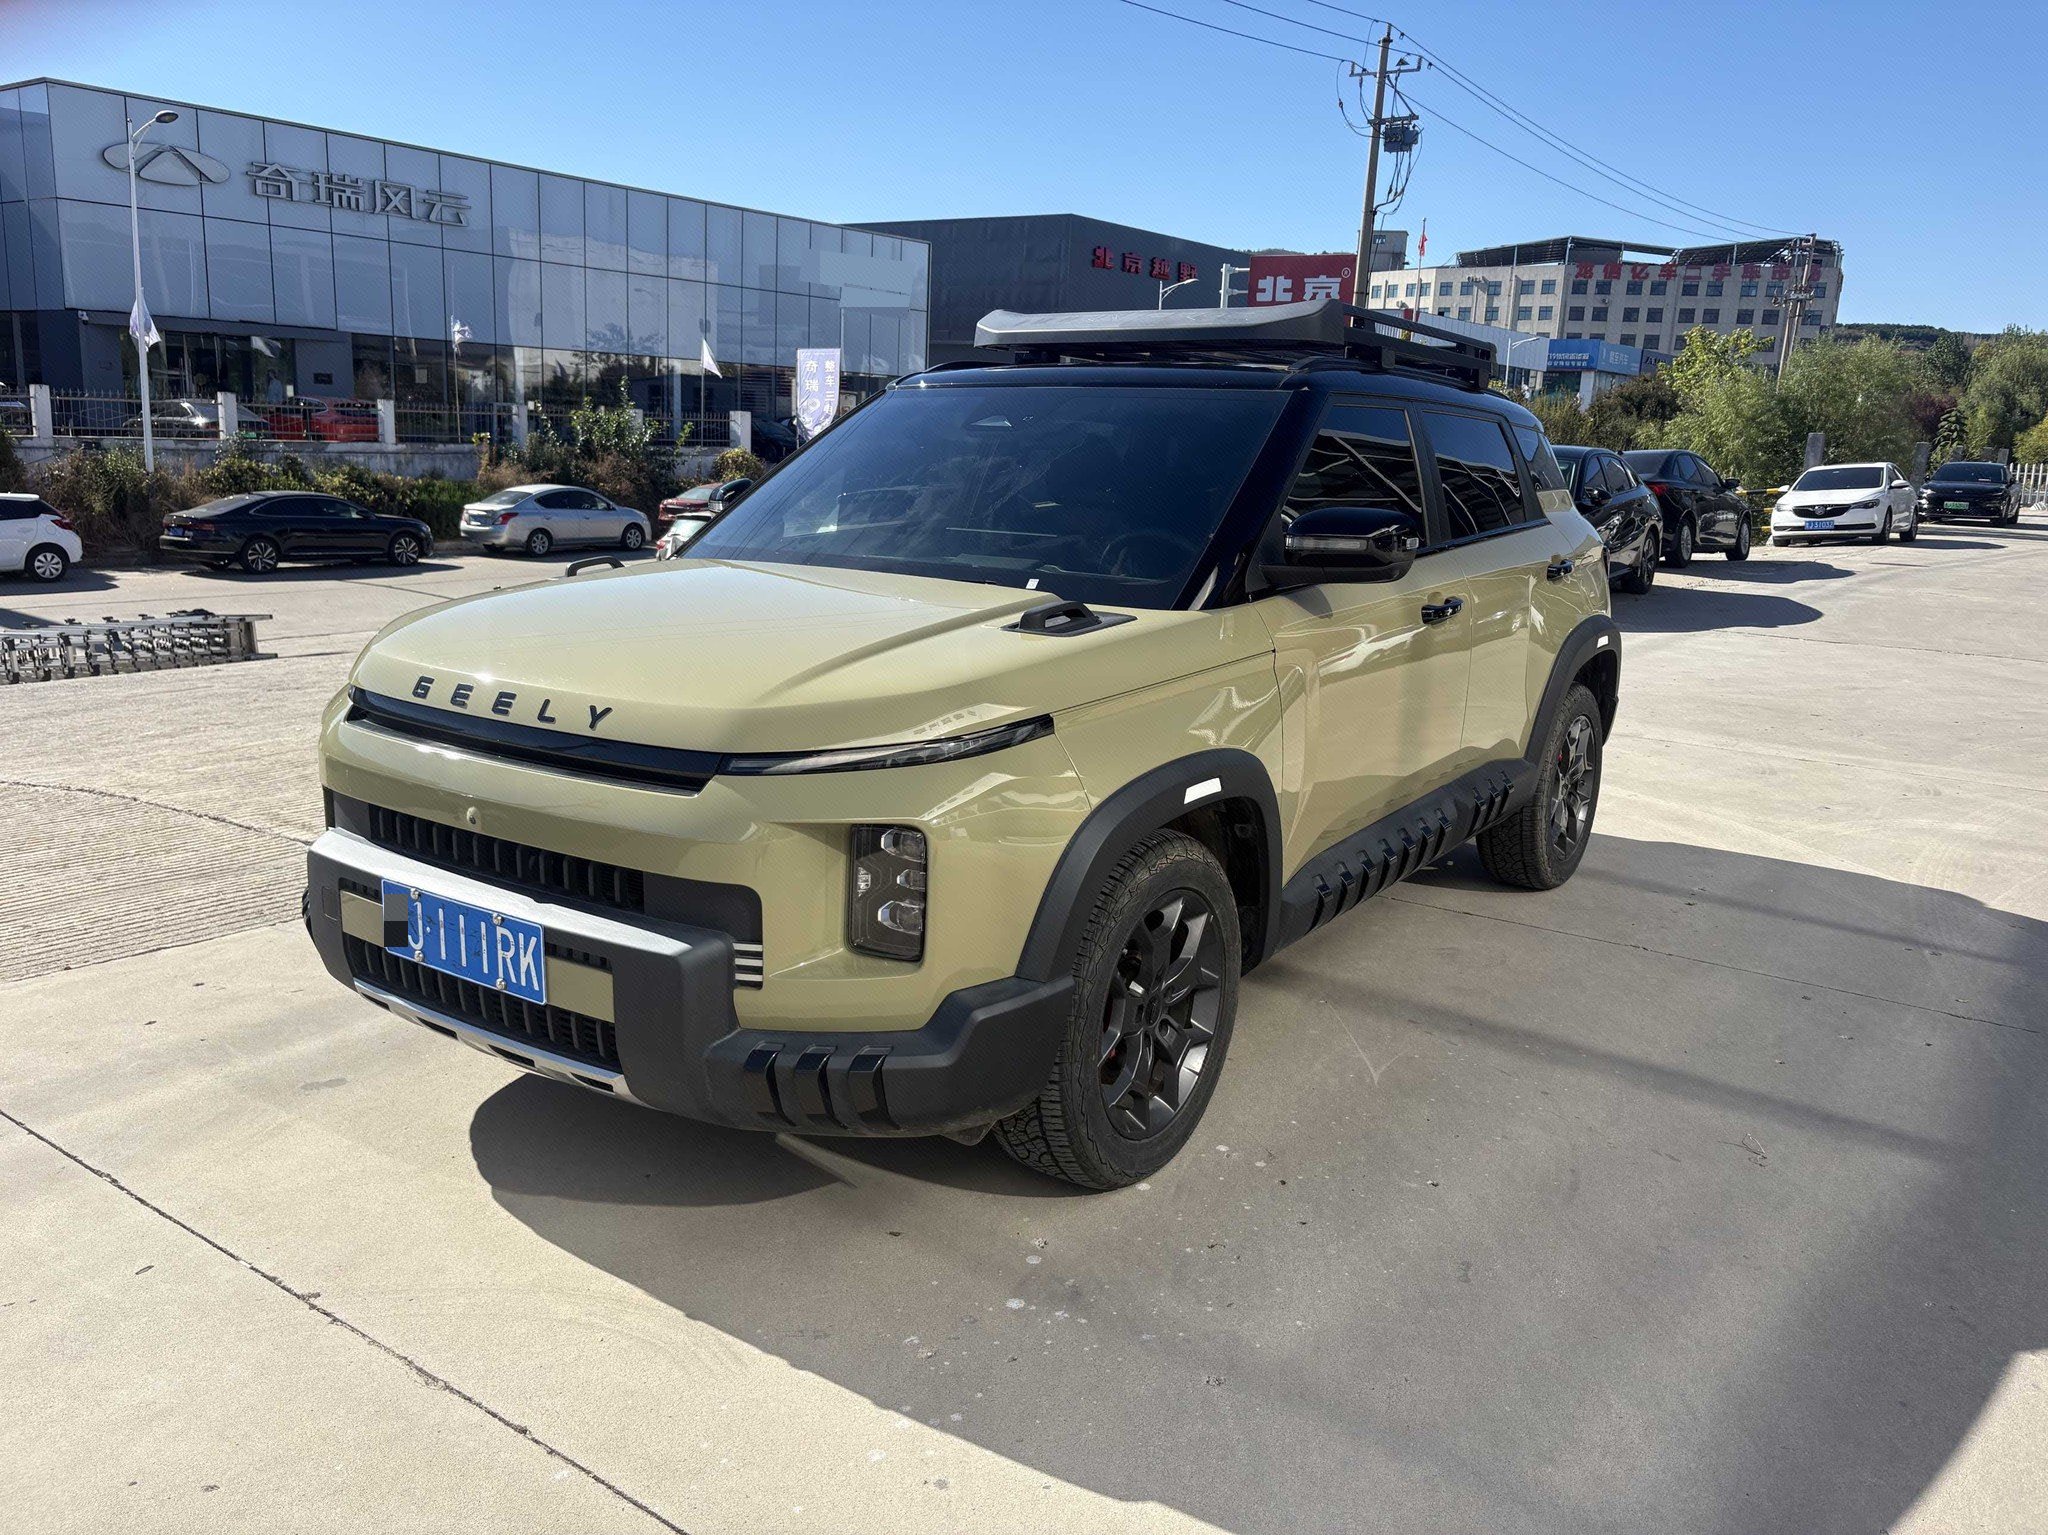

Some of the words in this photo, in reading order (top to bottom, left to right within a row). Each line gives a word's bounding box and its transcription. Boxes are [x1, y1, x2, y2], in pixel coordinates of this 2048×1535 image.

[246, 162, 472, 227] 奇瑞风云
[1092, 246, 1199, 282] 北京越野
[1255, 274, 1342, 302] 北京
[411, 675, 613, 732] GEELY
[386, 897, 539, 991] J·111RK
